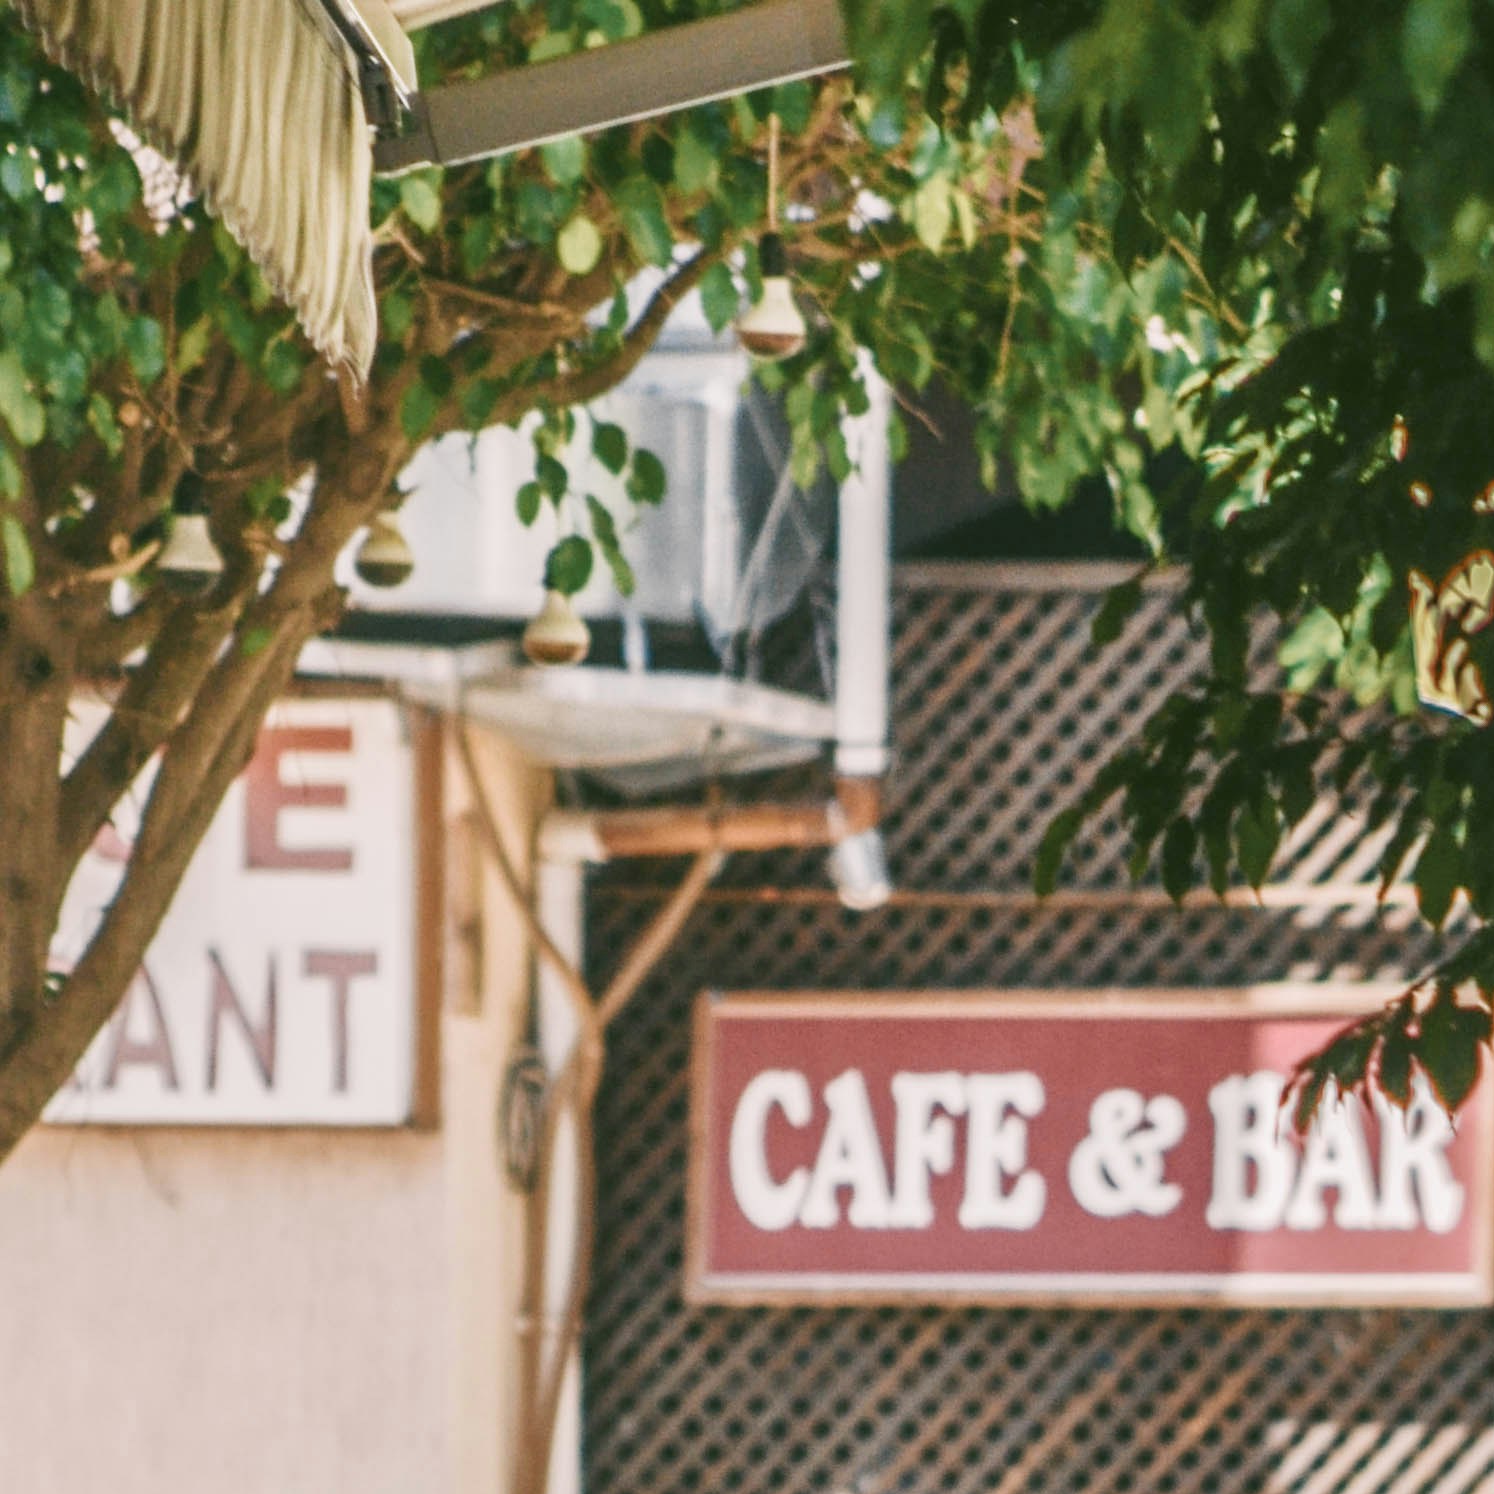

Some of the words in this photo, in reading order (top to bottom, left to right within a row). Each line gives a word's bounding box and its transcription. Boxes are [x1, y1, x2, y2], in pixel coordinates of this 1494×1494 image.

[74, 947, 378, 1095] ANT
[729, 1068, 1046, 1232] CAFE
[1069, 1088, 1188, 1219] &
[1206, 1068, 1465, 1234] BAR
